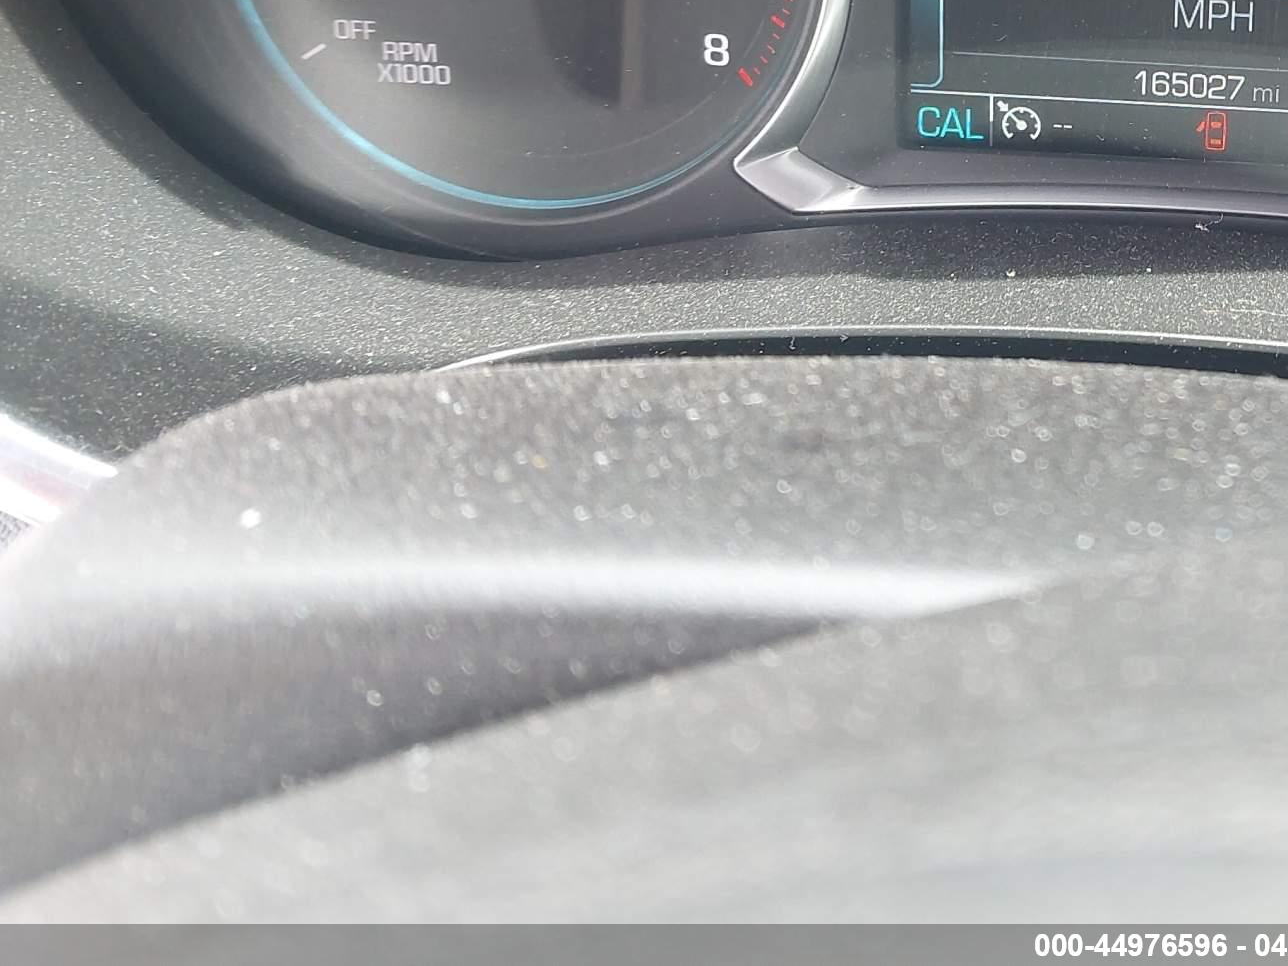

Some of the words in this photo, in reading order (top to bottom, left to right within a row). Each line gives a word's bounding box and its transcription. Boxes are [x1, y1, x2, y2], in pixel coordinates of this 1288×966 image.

[333, 21, 376, 40] OFF
[382, 43, 438, 63] RPM
[703, 34, 730, 67] 8
[377, 64, 451, 86] X1000
[1135, 70, 1245, 102] 165027
[1252, 83, 1280, 103] mi
[917, 106, 984, 140] CAL
